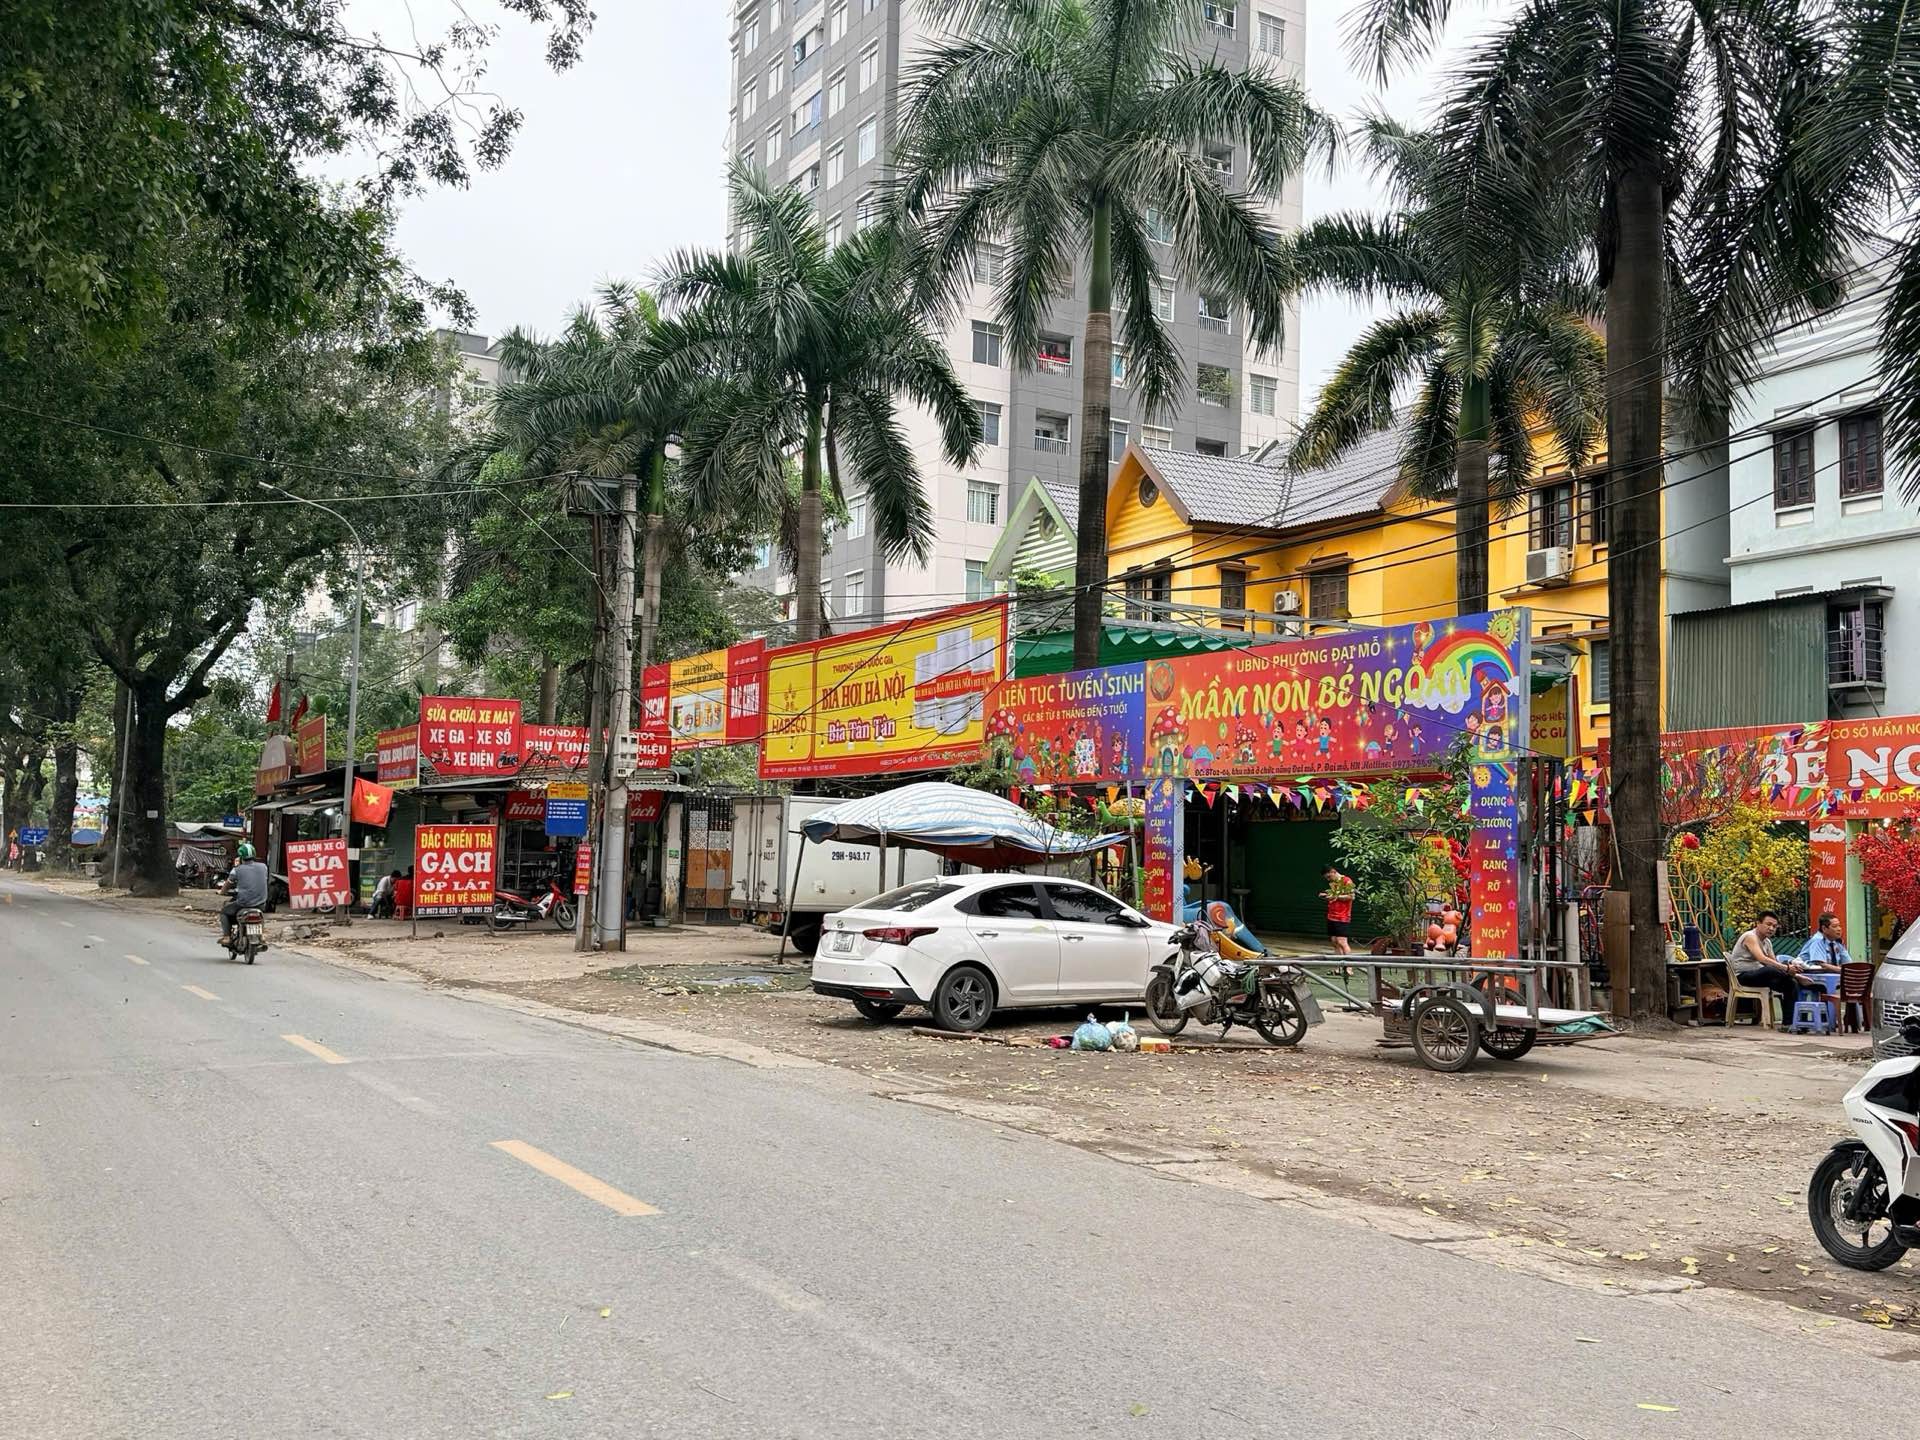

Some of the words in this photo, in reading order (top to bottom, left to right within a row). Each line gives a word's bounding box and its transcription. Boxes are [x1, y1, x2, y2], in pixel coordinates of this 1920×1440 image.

[1236, 657, 1269, 673] UBND
[1273, 648, 1328, 669] PHƯỜNG
[1331, 645, 1354, 664] ĐẠI
[1358, 636, 1381, 659] MỖ
[822, 686, 839, 710] BIA
[842, 682, 863, 708] HƠI
[865, 672, 882, 704] HÀ
[884, 669, 906, 706] NỘI
[999, 685, 1027, 709] LIÊN
[1030, 684, 1055, 708] TỤC
[1059, 672, 1103, 702] TUYỂN
[1106, 673, 1145, 697] SINH
[1180, 674, 1249, 721] MẦM
[1253, 678, 1311, 716] NON
[1318, 664, 1355, 710] BÉ
[1360, 658, 1474, 709] NGOAN
[427, 704, 447, 722] SỬA
[449, 706, 476, 724] CHỮA
[477, 710, 491, 724] XE
[493, 708, 516, 725] MÁY
[1022, 710, 1035, 723] CÁC
[1036, 708, 1044, 722] BÉ
[1045, 709, 1056, 721] TỪ
[1056, 710, 1061, 720] 8
[1062, 705, 1086, 720] THÁNG
[1087, 702, 1103, 718] ĐẾN
[1103, 704, 1109, 715] 5
[1109, 700, 1128, 715] TUỔI
[429, 728, 446, 744] XE
[449, 729, 465, 744] GA
[477, 730, 492, 745] XE
[495, 726, 512, 745] SỐ
[539, 728, 577, 738] HONDA
[828, 720, 846, 743] Bia
[1831, 727, 1850, 740] CƠ
[1852, 723, 1869, 738] SỞ
[1872, 721, 1903, 737] MẦM
[454, 752, 468, 767] XE
[469, 750, 494, 770] ĐIỆN
[1879, 791, 1906, 803] KIDS
[421, 827, 441, 849] ĐẮC
[443, 827, 473, 849] CHIẾN
[1485, 838, 1501, 850] LAI
[288, 844, 306, 854] MUA
[307, 843, 322, 852] BÁN
[324, 842, 334, 851] XE
[291, 852, 344, 873] SỬA
[421, 851, 492, 880] GẠCH
[1482, 859, 1508, 872] RẠNG
[302, 874, 335, 890] XE
[421, 877, 448, 891] ỐP
[291, 889, 348, 909] MÁY
[419, 891, 444, 904] THIẾT
[446, 893, 456, 905] BỊ
[457, 891, 469, 905] VỆ
[471, 892, 493, 903] SINH
[1483, 902, 1502, 913] CHO
[1481, 926, 1508, 939] NGÀY
[1487, 949, 1506, 960] MAI
